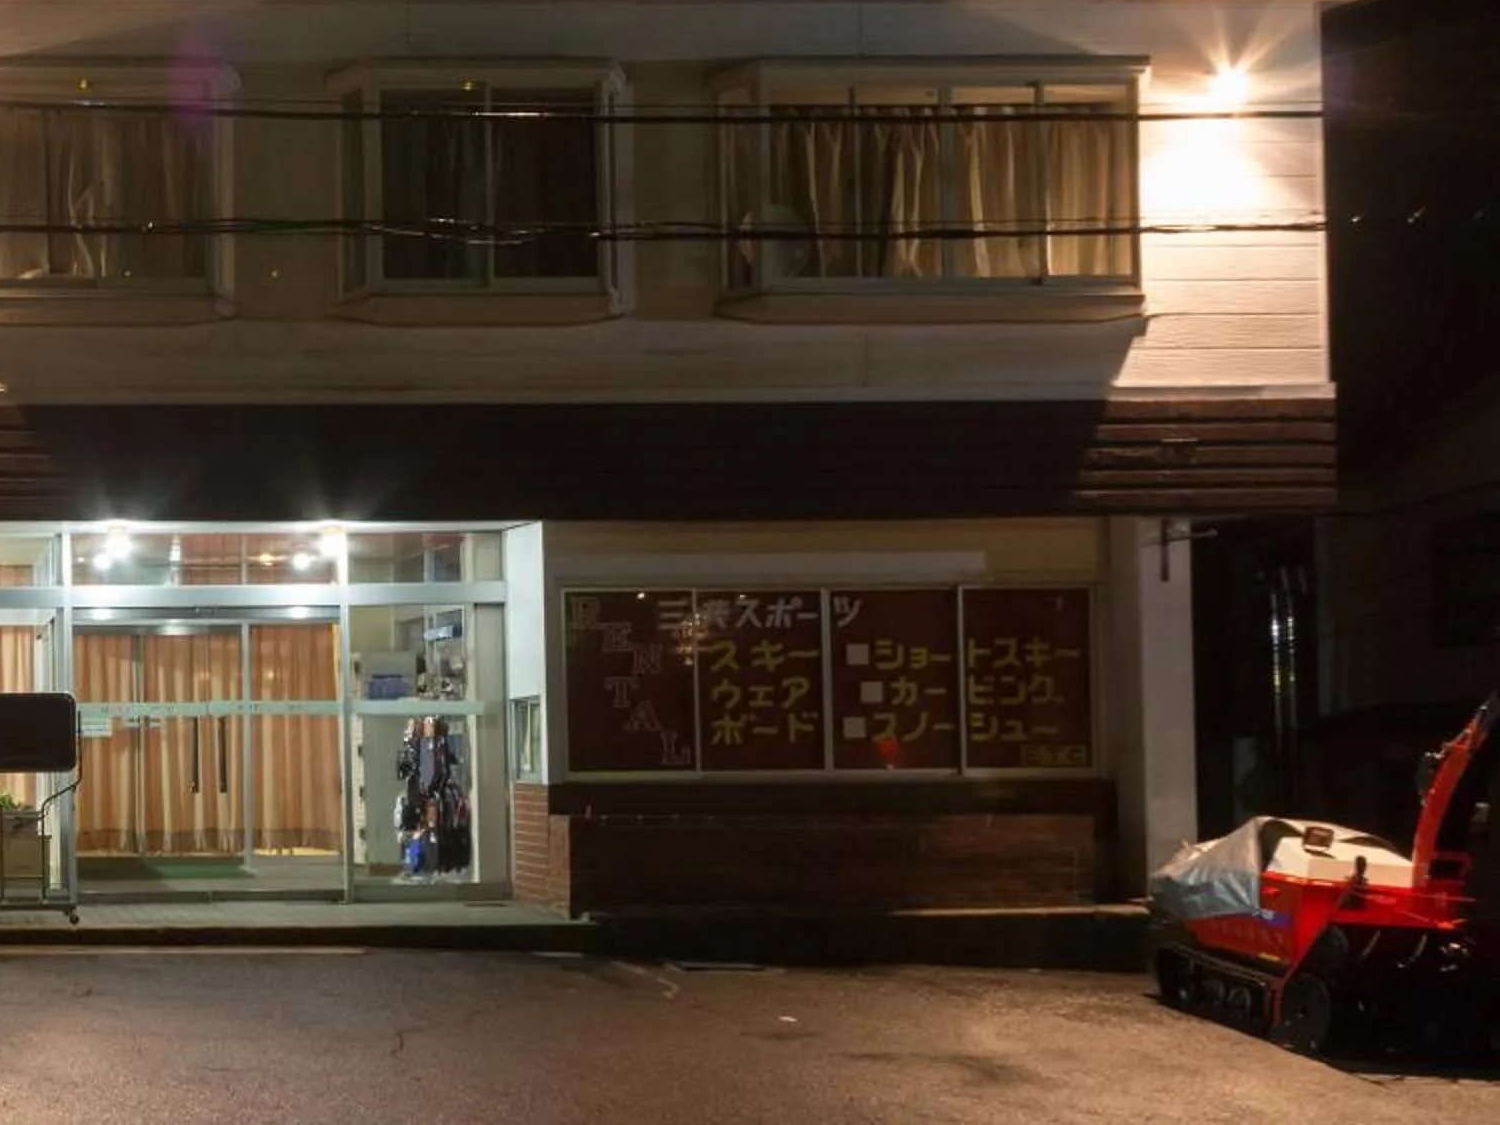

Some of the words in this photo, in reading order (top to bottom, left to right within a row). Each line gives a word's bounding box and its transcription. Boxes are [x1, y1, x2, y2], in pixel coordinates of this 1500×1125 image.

[709, 639, 820, 672] スキー
[875, 636, 1082, 670] ショートスキー
[711, 712, 819, 746] ボード
[872, 710, 1060, 743] スノーシュー
